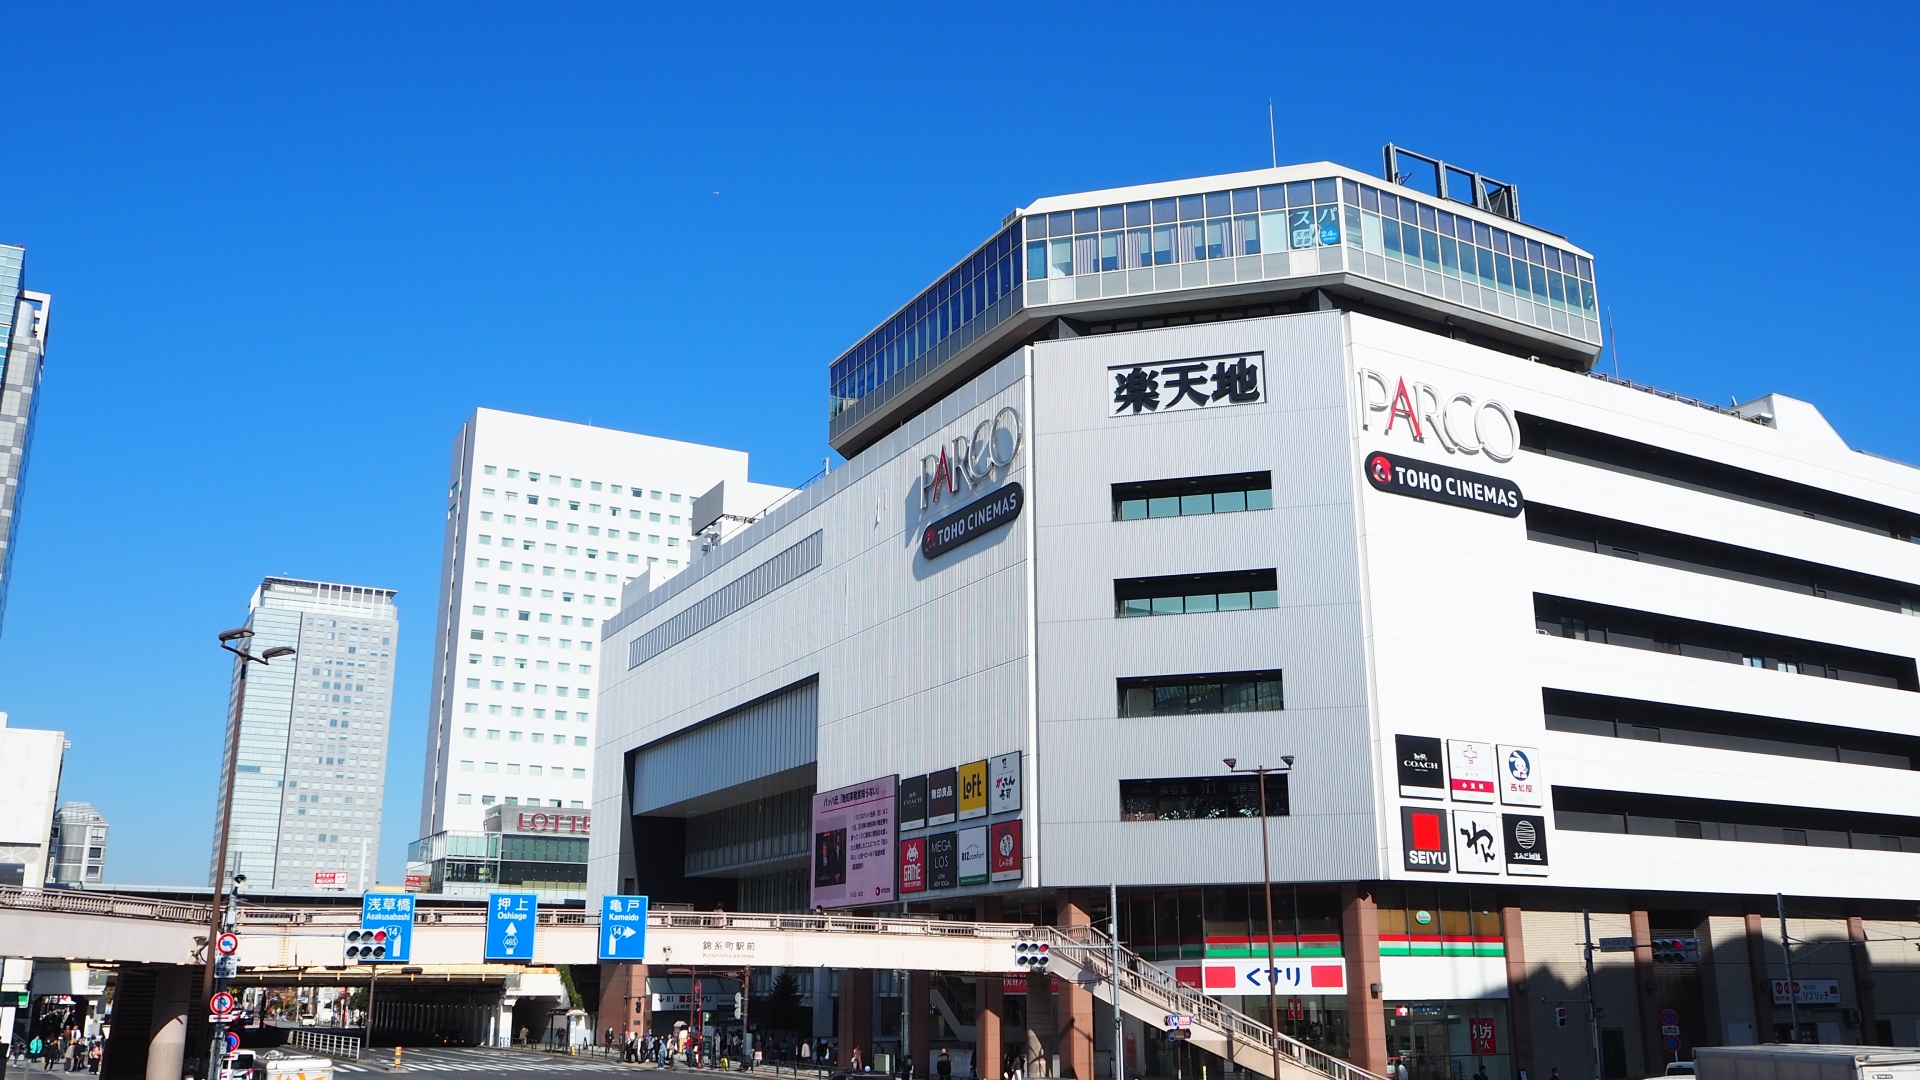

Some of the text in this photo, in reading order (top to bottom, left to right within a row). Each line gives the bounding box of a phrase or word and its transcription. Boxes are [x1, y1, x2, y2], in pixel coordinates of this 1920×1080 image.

[1294, 207, 1337, 227] スパ
[1114, 357, 1260, 415] 楽天地
[1358, 367, 1521, 463] PARCO
[920, 407, 1023, 509] PARCO
[1396, 466, 1518, 508] TOHO CINEMAS
[938, 493, 1017, 545] TOHO CINEMAS
[1403, 759, 1438, 770] COACH
[931, 786, 952, 800] 無印良品
[931, 840, 952, 853] MEGA
[934, 855, 949, 868] LOS
[1409, 850, 1447, 865] SEIYU
[904, 863, 921, 881] GAME
[367, 897, 411, 912] 浅草橋
[497, 897, 529, 911] 押上
[609, 899, 640, 912] 亀戸
[366, 912, 411, 921] Asakusabashi
[497, 912, 527, 921] Oshiage
[609, 913, 640, 921] Kameido
[388, 927, 398, 936] 14
[612, 927, 621, 936] 14
[505, 938, 516, 946] 465
[703, 940, 756, 951] 錦糸町駅前
[1246, 967, 1301, 986] くすり
